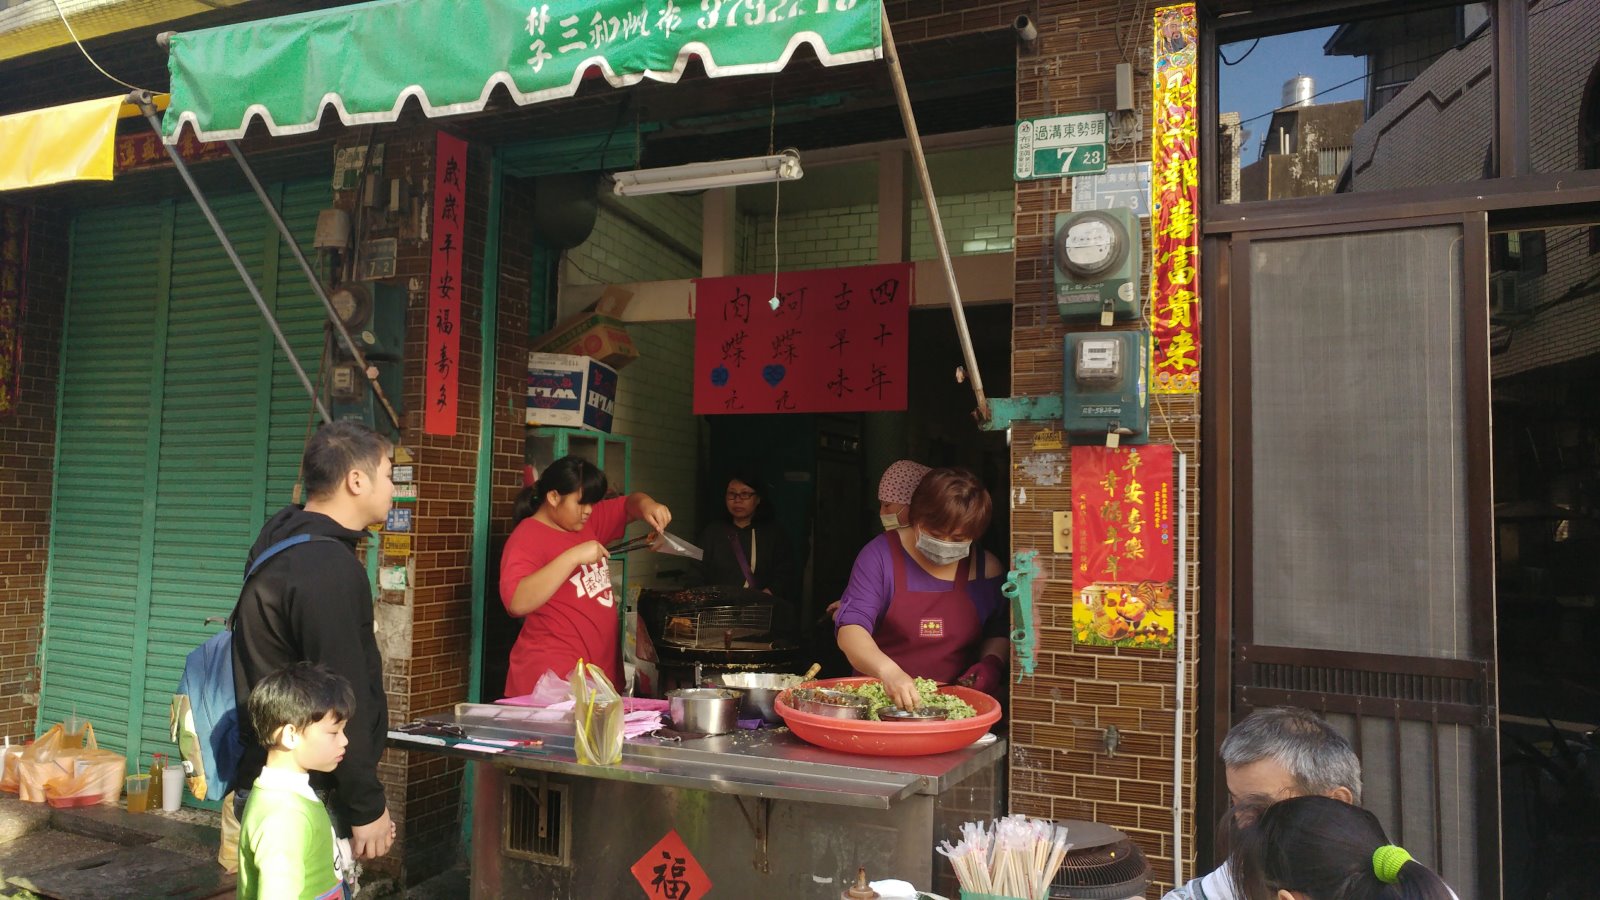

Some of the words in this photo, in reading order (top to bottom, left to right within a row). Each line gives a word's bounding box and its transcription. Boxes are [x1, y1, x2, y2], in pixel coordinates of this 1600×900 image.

[1035, 120, 1104, 141] 過溝東勢頭
[1057, 147, 1078, 173] 7
[1083, 151, 1101, 164] 之3
[434, 157, 461, 412] 歲歲平安福壽多
[828, 282, 853, 398] 古早味
[865, 278, 900, 401] 四十年
[1121, 452, 1146, 560] 平安喜樂
[651, 850, 691, 900] 福
